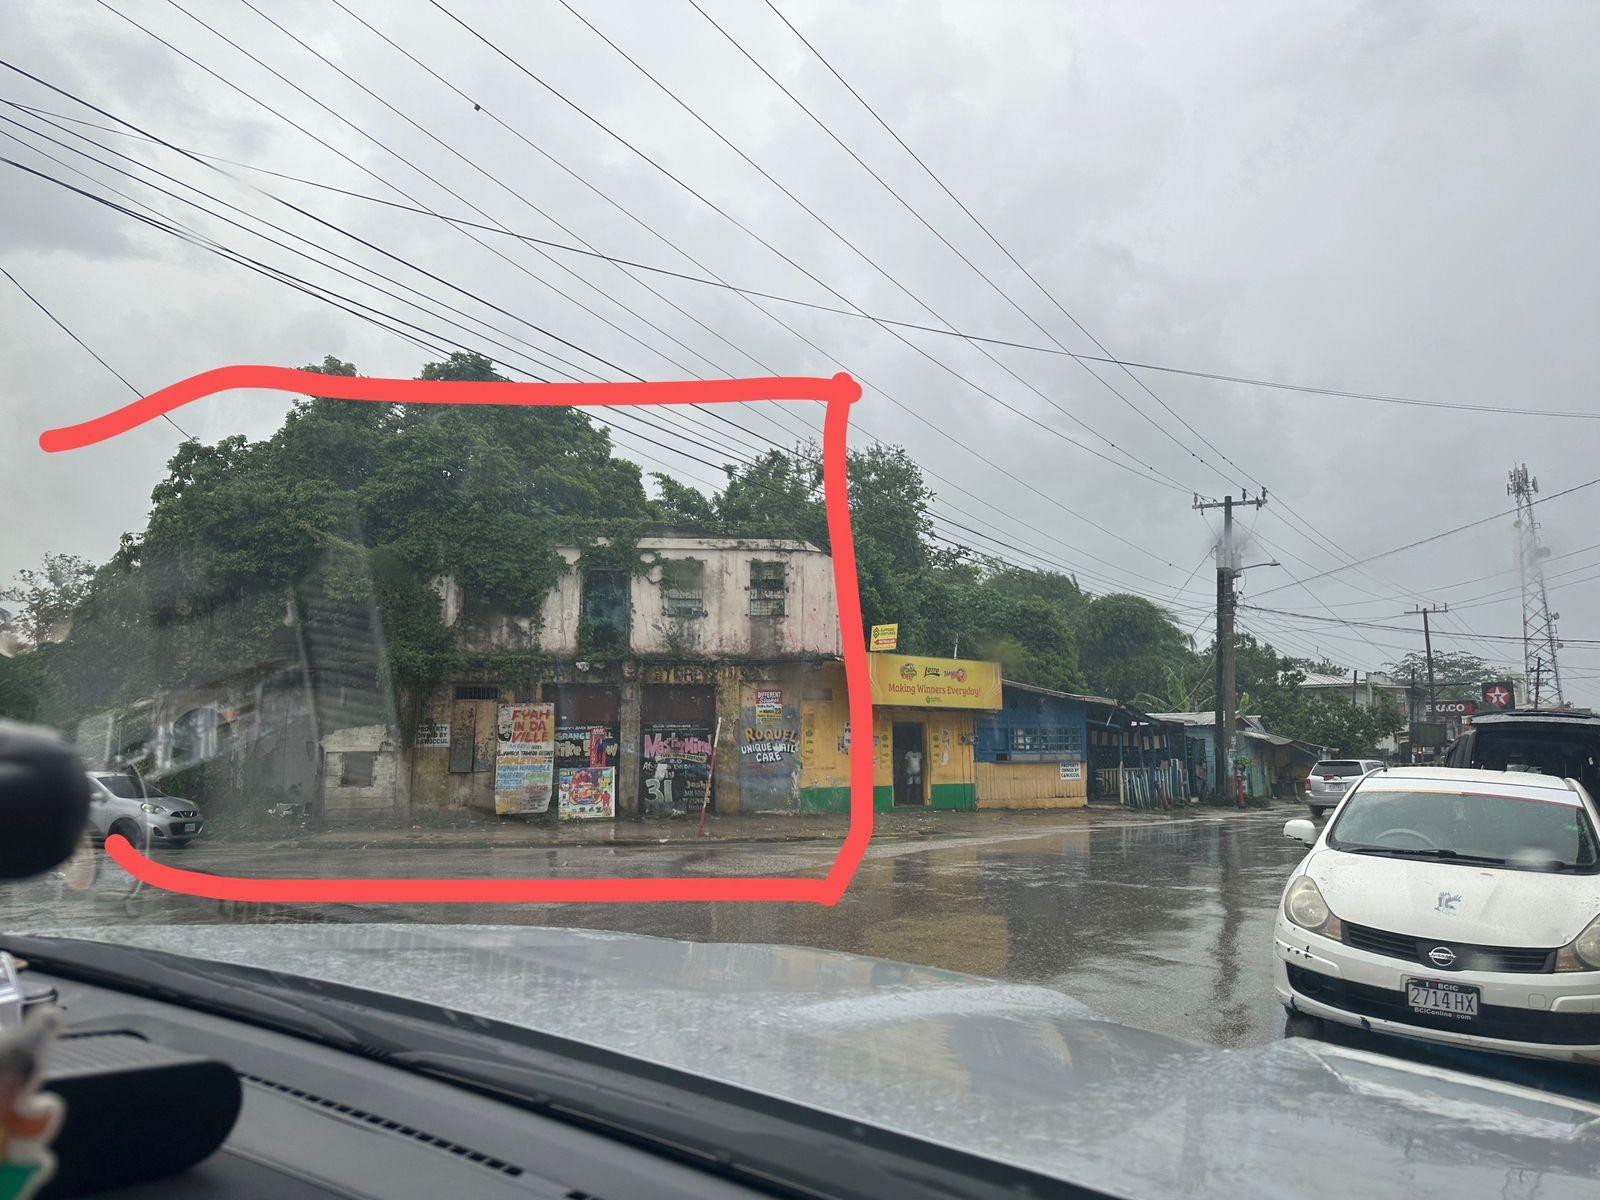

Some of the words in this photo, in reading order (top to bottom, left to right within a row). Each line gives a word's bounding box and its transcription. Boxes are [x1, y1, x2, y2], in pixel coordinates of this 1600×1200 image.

[888, 683, 916, 694] Making
[917, 684, 946, 694] Winners
[947, 686, 981, 698] Everyday!
[1425, 703, 1465, 712] EXACO
[512, 709, 550, 721] FYAH
[514, 721, 525, 731] IN
[530, 720, 546, 731] DA
[511, 731, 549, 743] VILLE
[555, 732, 591, 741] GRANGE
[741, 742, 772, 754] UNIQUE
[773, 743, 796, 753] AIL
[756, 752, 782, 762] CARE
[645, 778, 673, 802] 31
[1411, 987, 1450, 1009] 2714
[1455, 994, 1474, 1012] HX
